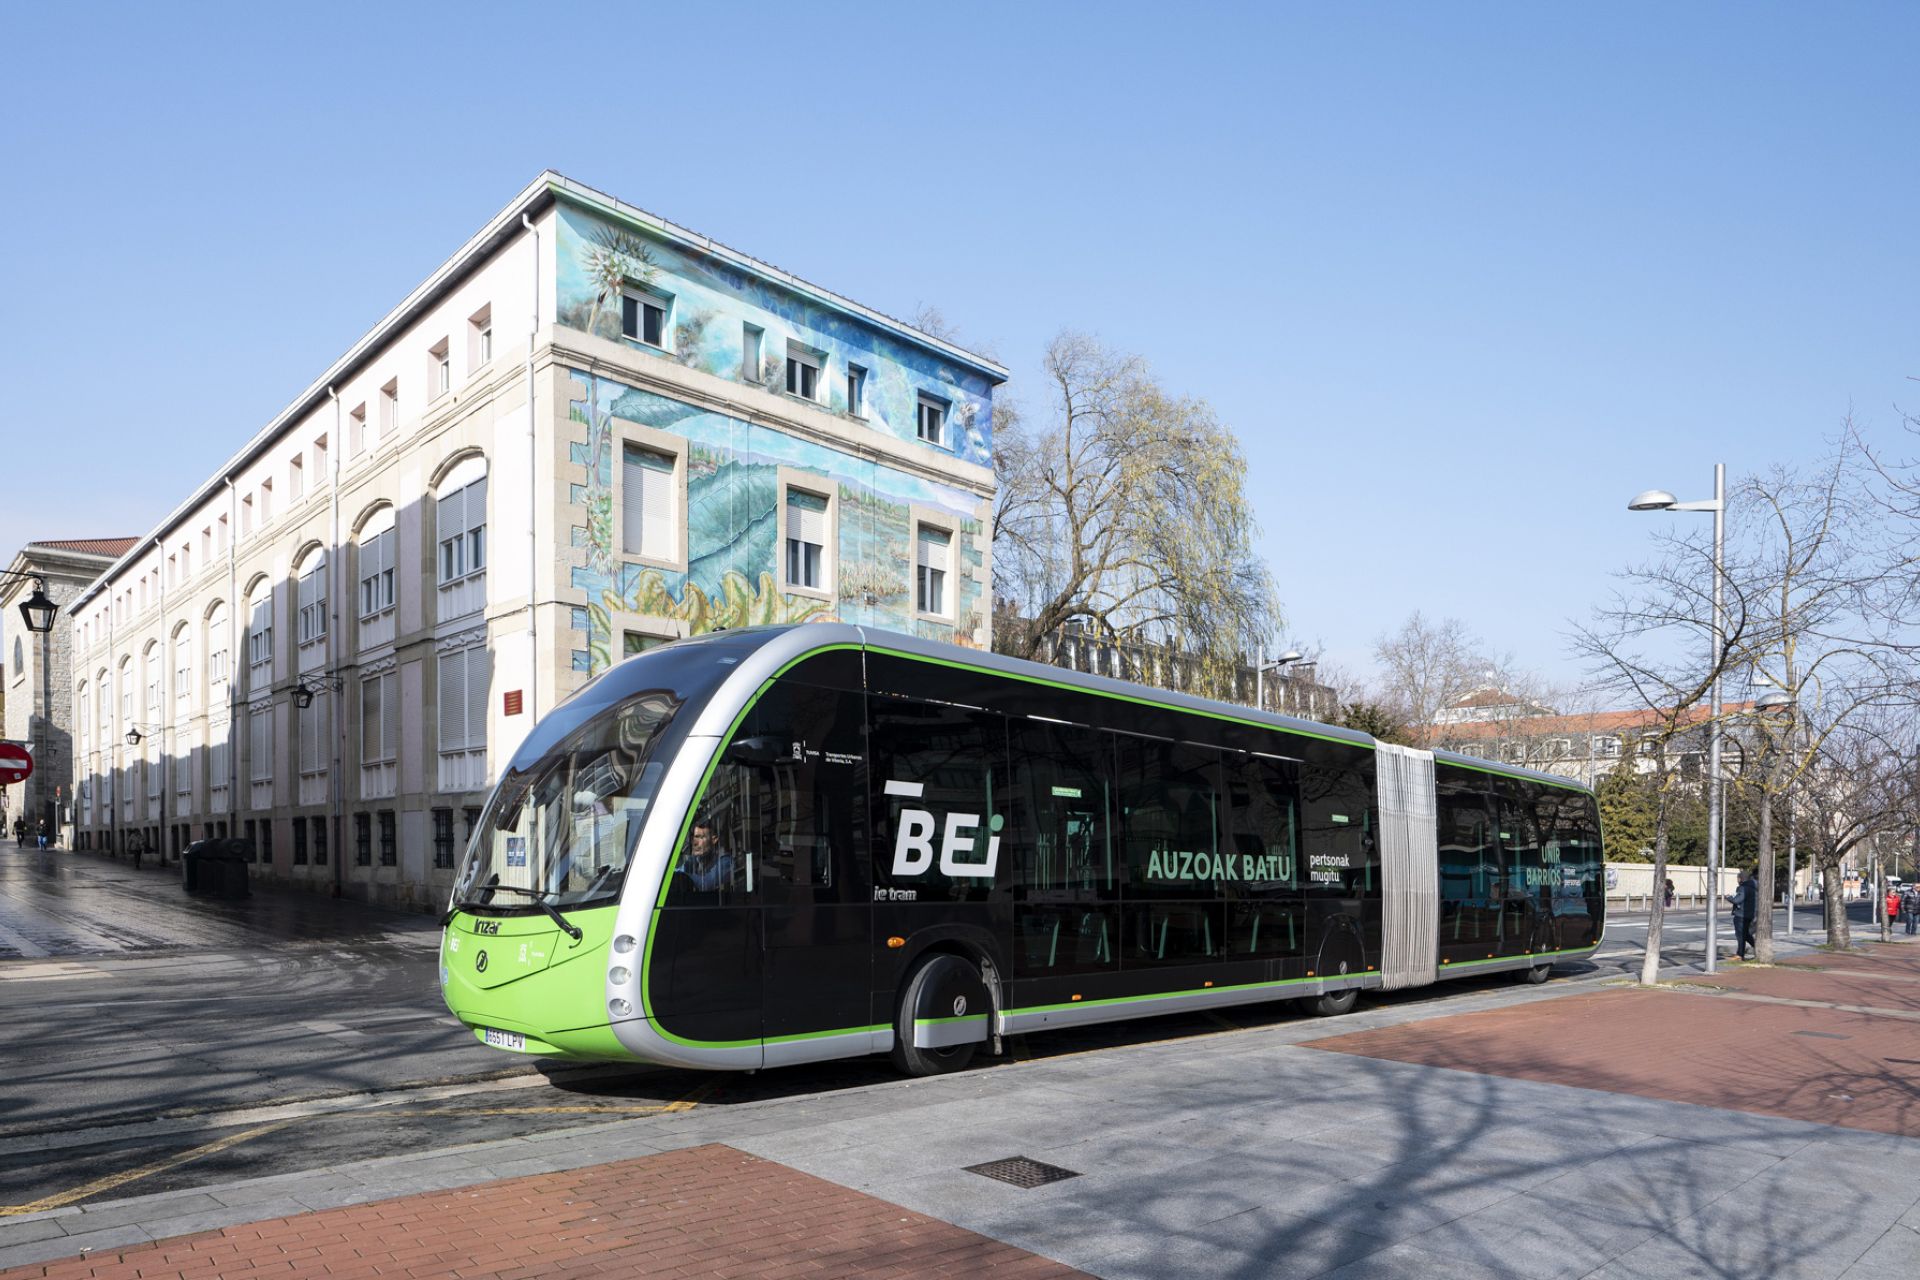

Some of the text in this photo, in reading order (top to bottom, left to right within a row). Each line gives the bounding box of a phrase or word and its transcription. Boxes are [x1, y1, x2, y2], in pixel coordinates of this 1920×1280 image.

[1309, 853, 1350, 868] pertsonak
[1541, 845, 1560, 864] UNIR
[1147, 850, 1290, 881] AUZOAK BATU
[1310, 868, 1340, 885] mugitu
[1526, 868, 1561, 887] BARRIOS
[874, 886, 917, 901] ie tram
